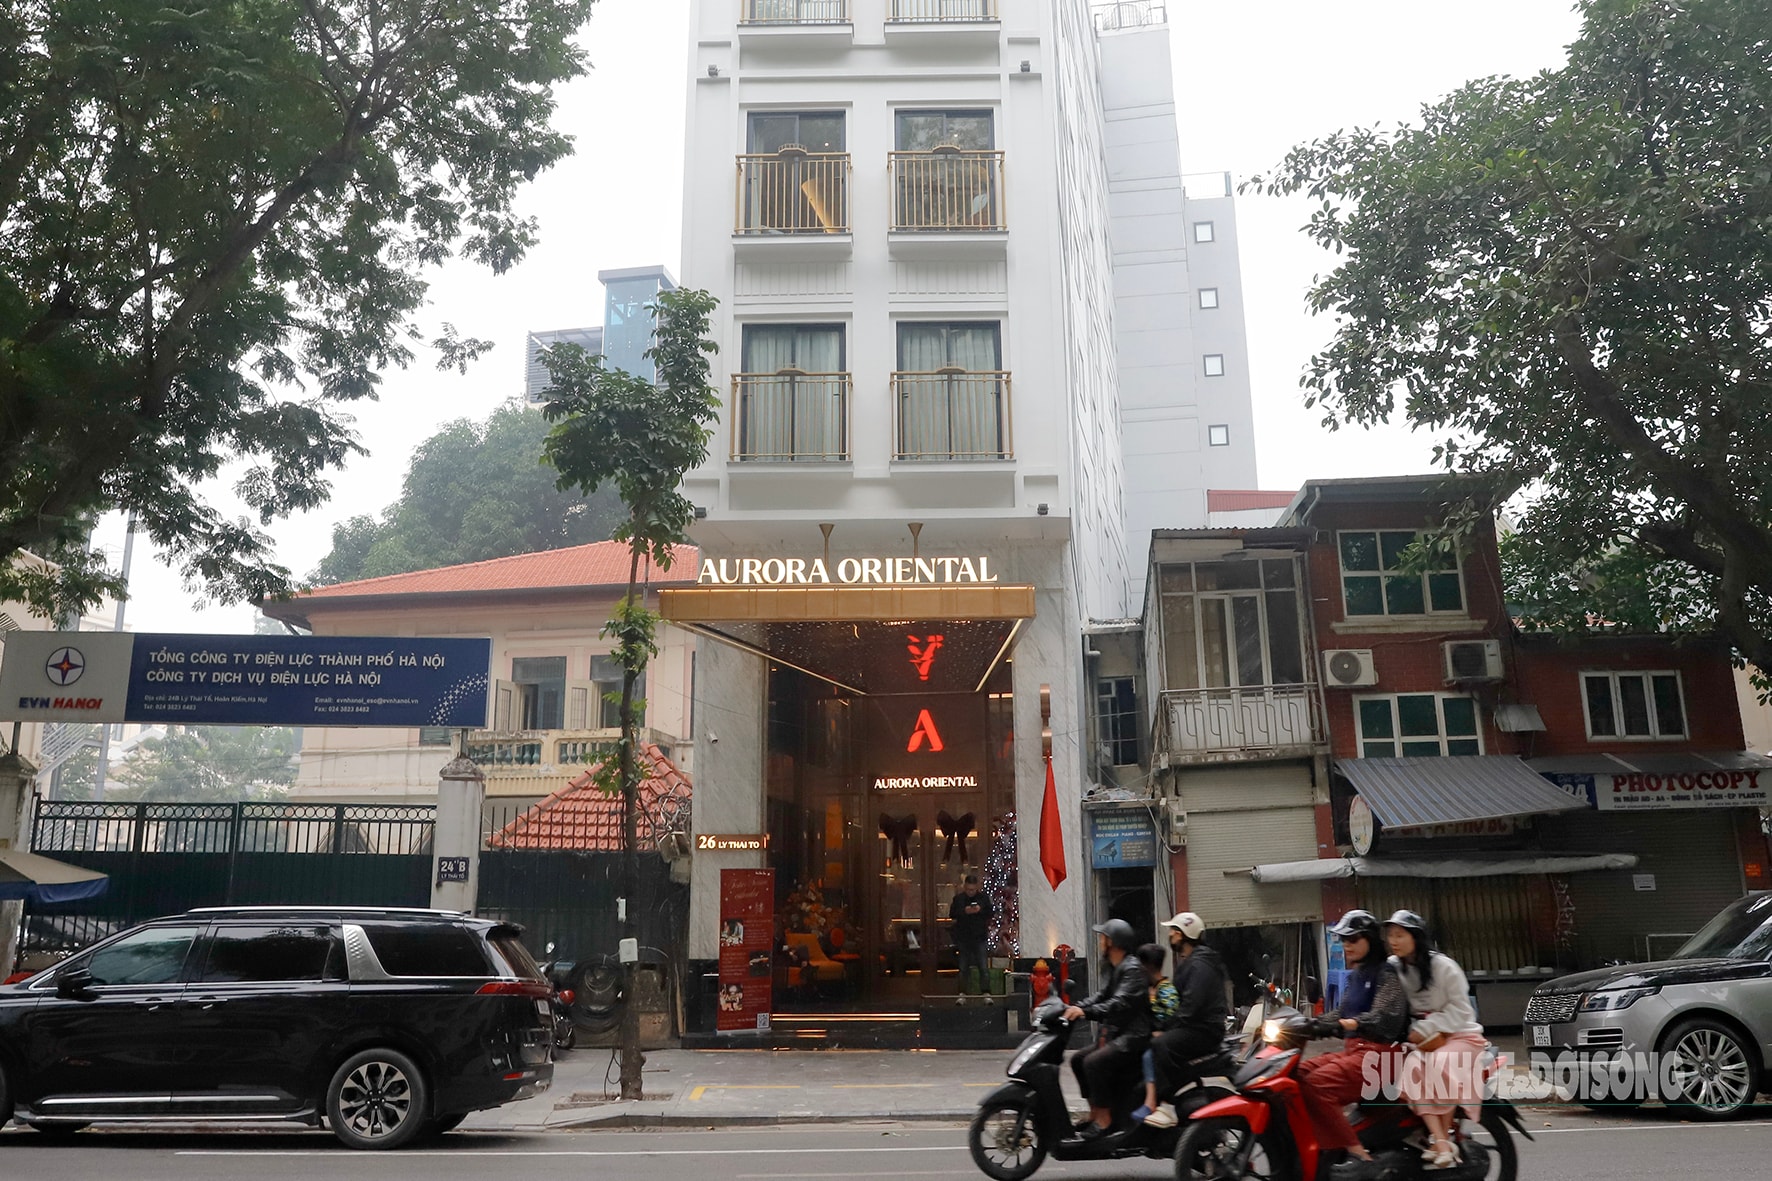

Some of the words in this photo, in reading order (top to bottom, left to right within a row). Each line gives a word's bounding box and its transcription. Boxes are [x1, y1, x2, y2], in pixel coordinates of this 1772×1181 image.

[697, 558, 830, 584] AURORA
[837, 557, 997, 583] ORIENTAL
[149, 646, 185, 664] TỔNG
[190, 650, 227, 664] CÔNG
[233, 653, 250, 665] TY
[255, 651, 285, 667] ĐIỆN
[288, 654, 314, 668] LỰC
[319, 652, 362, 666] THÀNH
[366, 650, 394, 666] PHỐ
[399, 652, 418, 667] HÀ
[422, 654, 446, 670] NỘI
[146, 668, 184, 682] CÔNG
[190, 672, 207, 682] TY
[212, 672, 242, 686] DỊCH
[248, 672, 265, 686] VỤ
[270, 670, 300, 686] ĐIỆN
[304, 672, 330, 687] LỰC
[335, 670, 354, 685] HÀ
[358, 672, 381, 688] NỘI
[18, 697, 50, 709] EVN
[53, 697, 103, 710] HANOI
[874, 777, 920, 790] AURORA
[922, 776, 978, 788] ORIENTAL
[1612, 770, 1760, 792] PHOTOCOPY
[698, 835, 716, 848] 26
